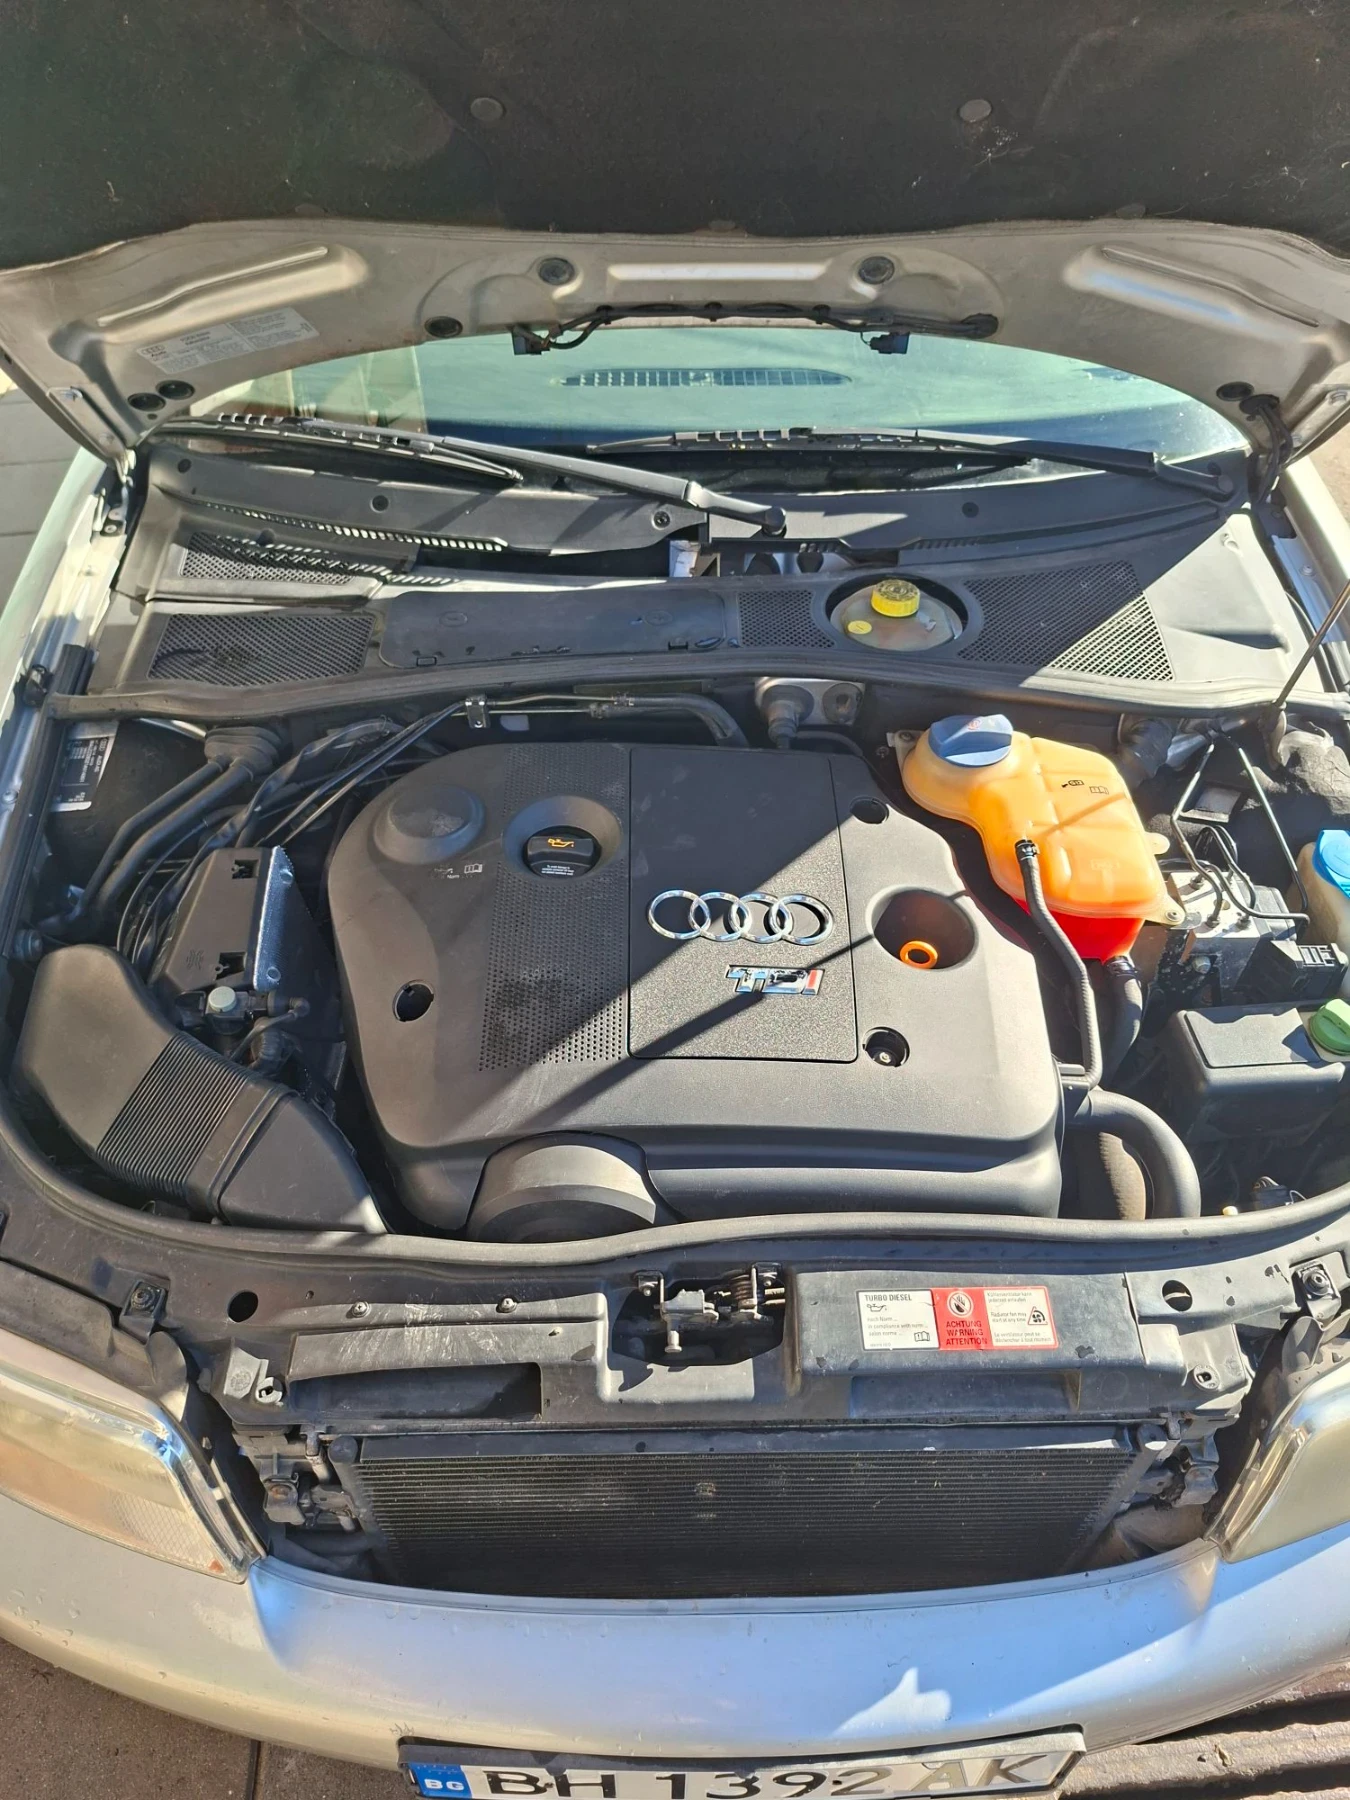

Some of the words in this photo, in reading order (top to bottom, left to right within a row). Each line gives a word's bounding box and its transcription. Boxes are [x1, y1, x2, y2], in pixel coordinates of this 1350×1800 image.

[725, 964, 825, 995] TDI
[946, 1320, 982, 1328] ACHTUNG
[946, 1328, 984, 1337] WARNING
[946, 1337, 988, 1345] ATTENTION
[482, 1769, 617, 1799] BH
[655, 1767, 894, 1799] 1392
[909, 1753, 1048, 1791] AK
[424, 1778, 466, 1791] BG
